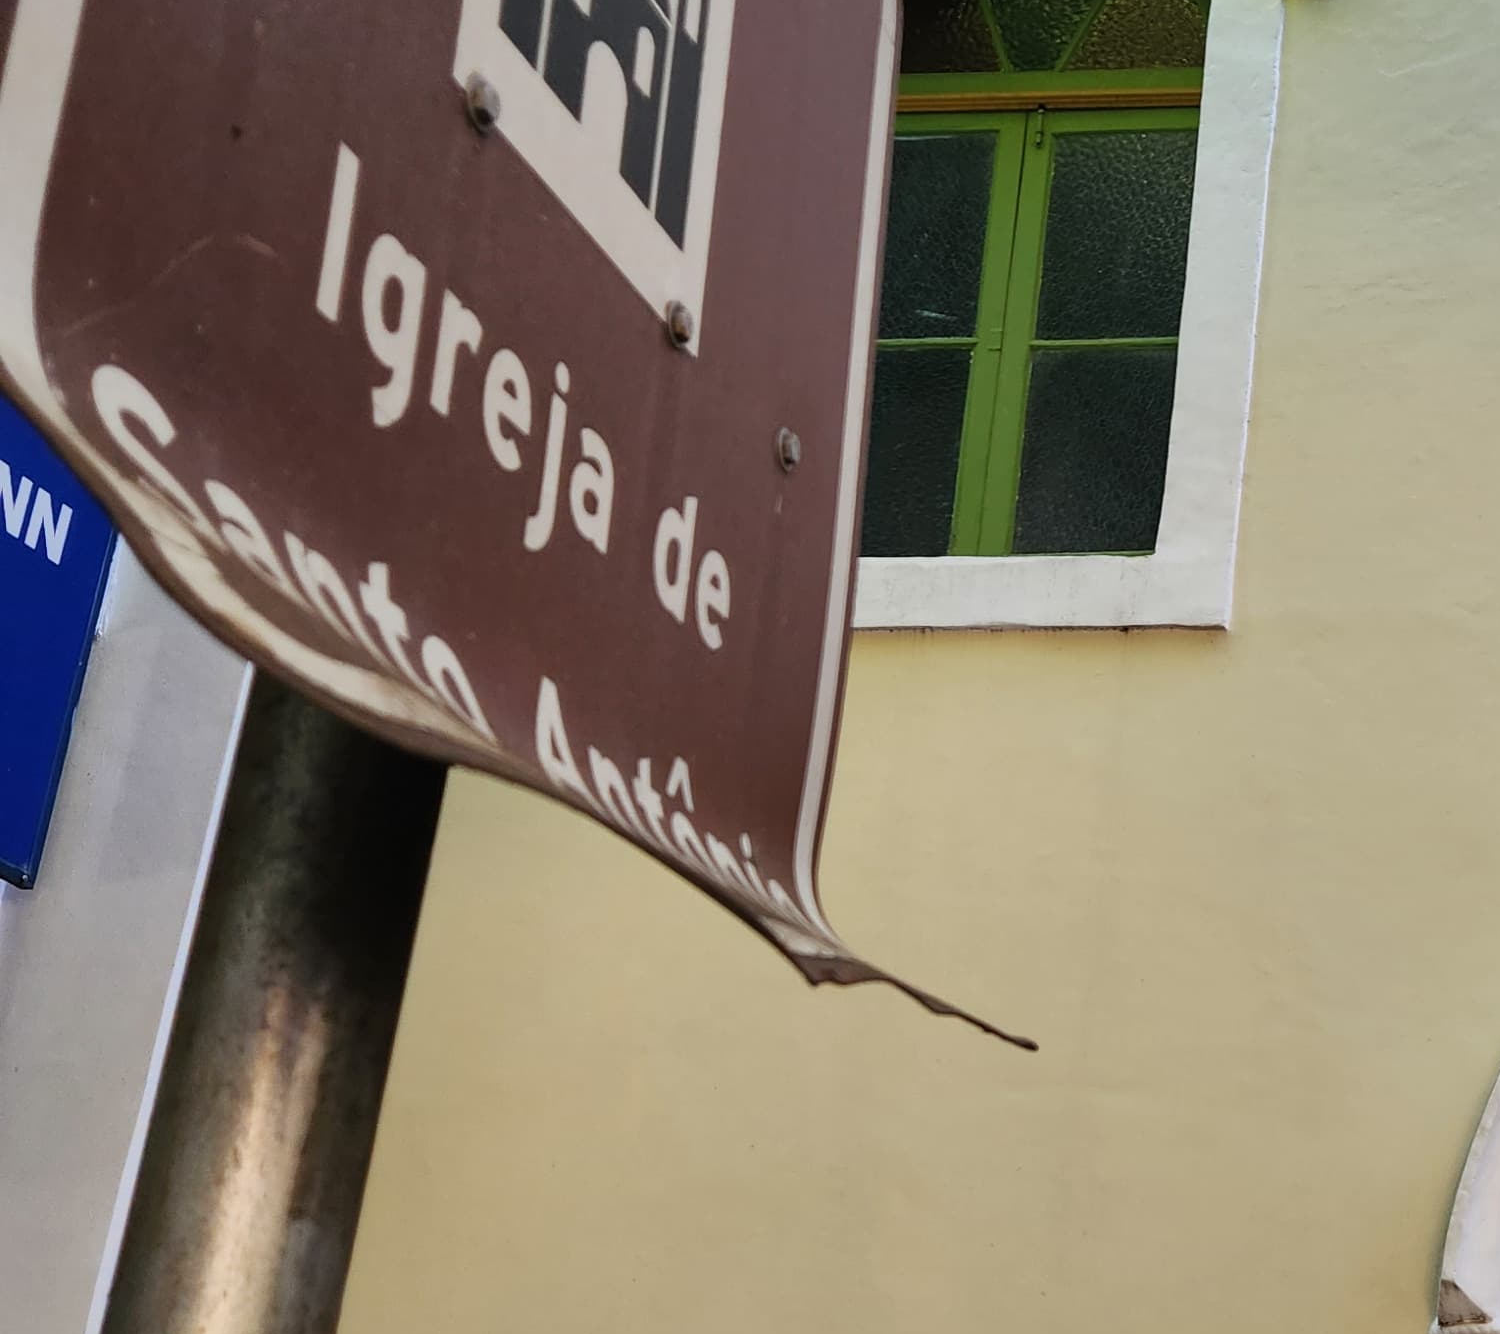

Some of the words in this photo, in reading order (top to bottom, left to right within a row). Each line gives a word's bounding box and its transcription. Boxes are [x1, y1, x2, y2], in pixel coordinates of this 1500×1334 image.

[90, 364, 498, 743] Santo
[316, 142, 615, 552] Igreja
[653, 497, 731, 649] de
